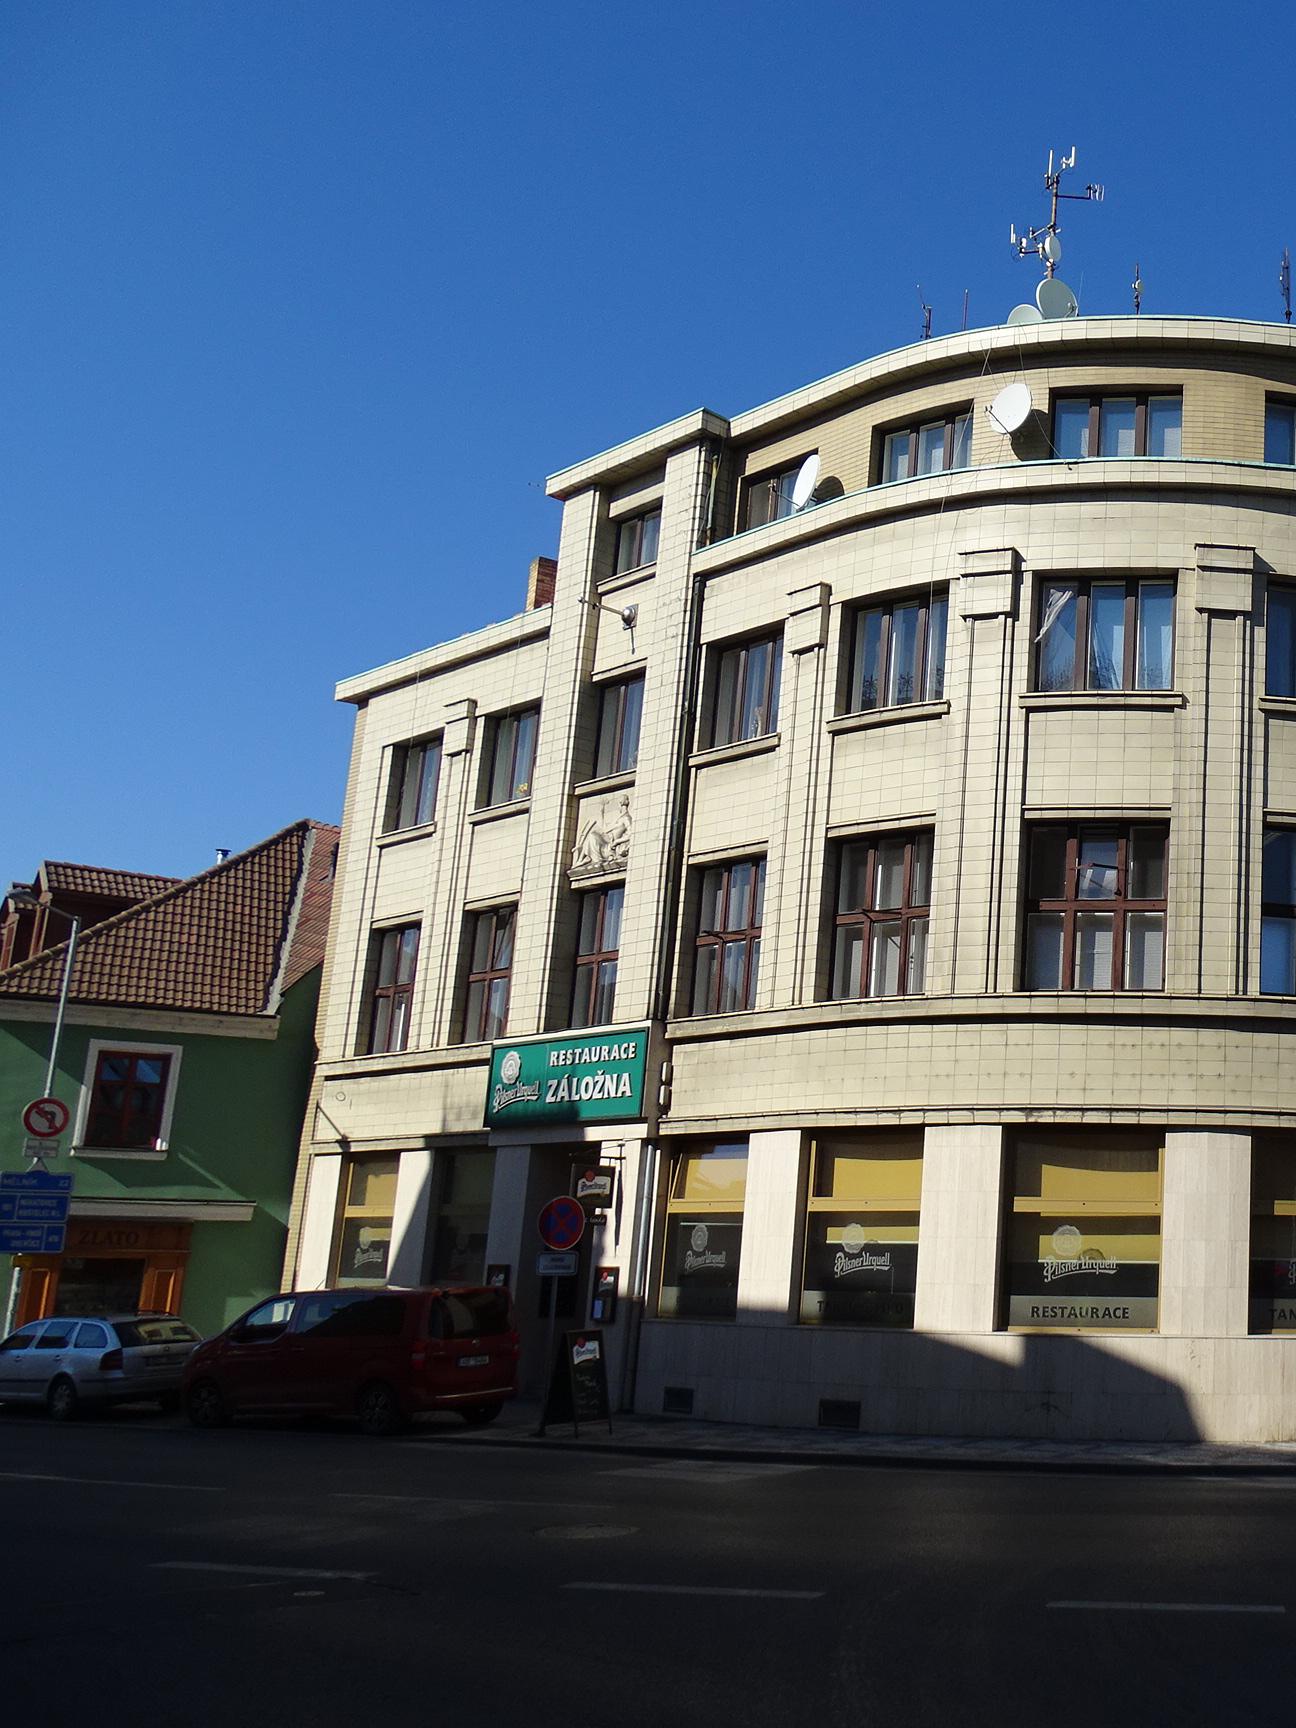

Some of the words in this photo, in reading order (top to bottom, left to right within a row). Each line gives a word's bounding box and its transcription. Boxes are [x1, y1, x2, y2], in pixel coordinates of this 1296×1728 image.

[549, 1042, 637, 1067] RESTAURACE
[545, 1070, 633, 1104] ZÁLOŽNA
[79, 1230, 140, 1246] ZLATO
[834, 1252, 863, 1278] Pilsner
[862, 1251, 890, 1271] Urquell
[1043, 1255, 1081, 1283] Pilsner
[1080, 1256, 1117, 1275] Urquell
[1030, 1306, 1130, 1319] RESTAURACE
